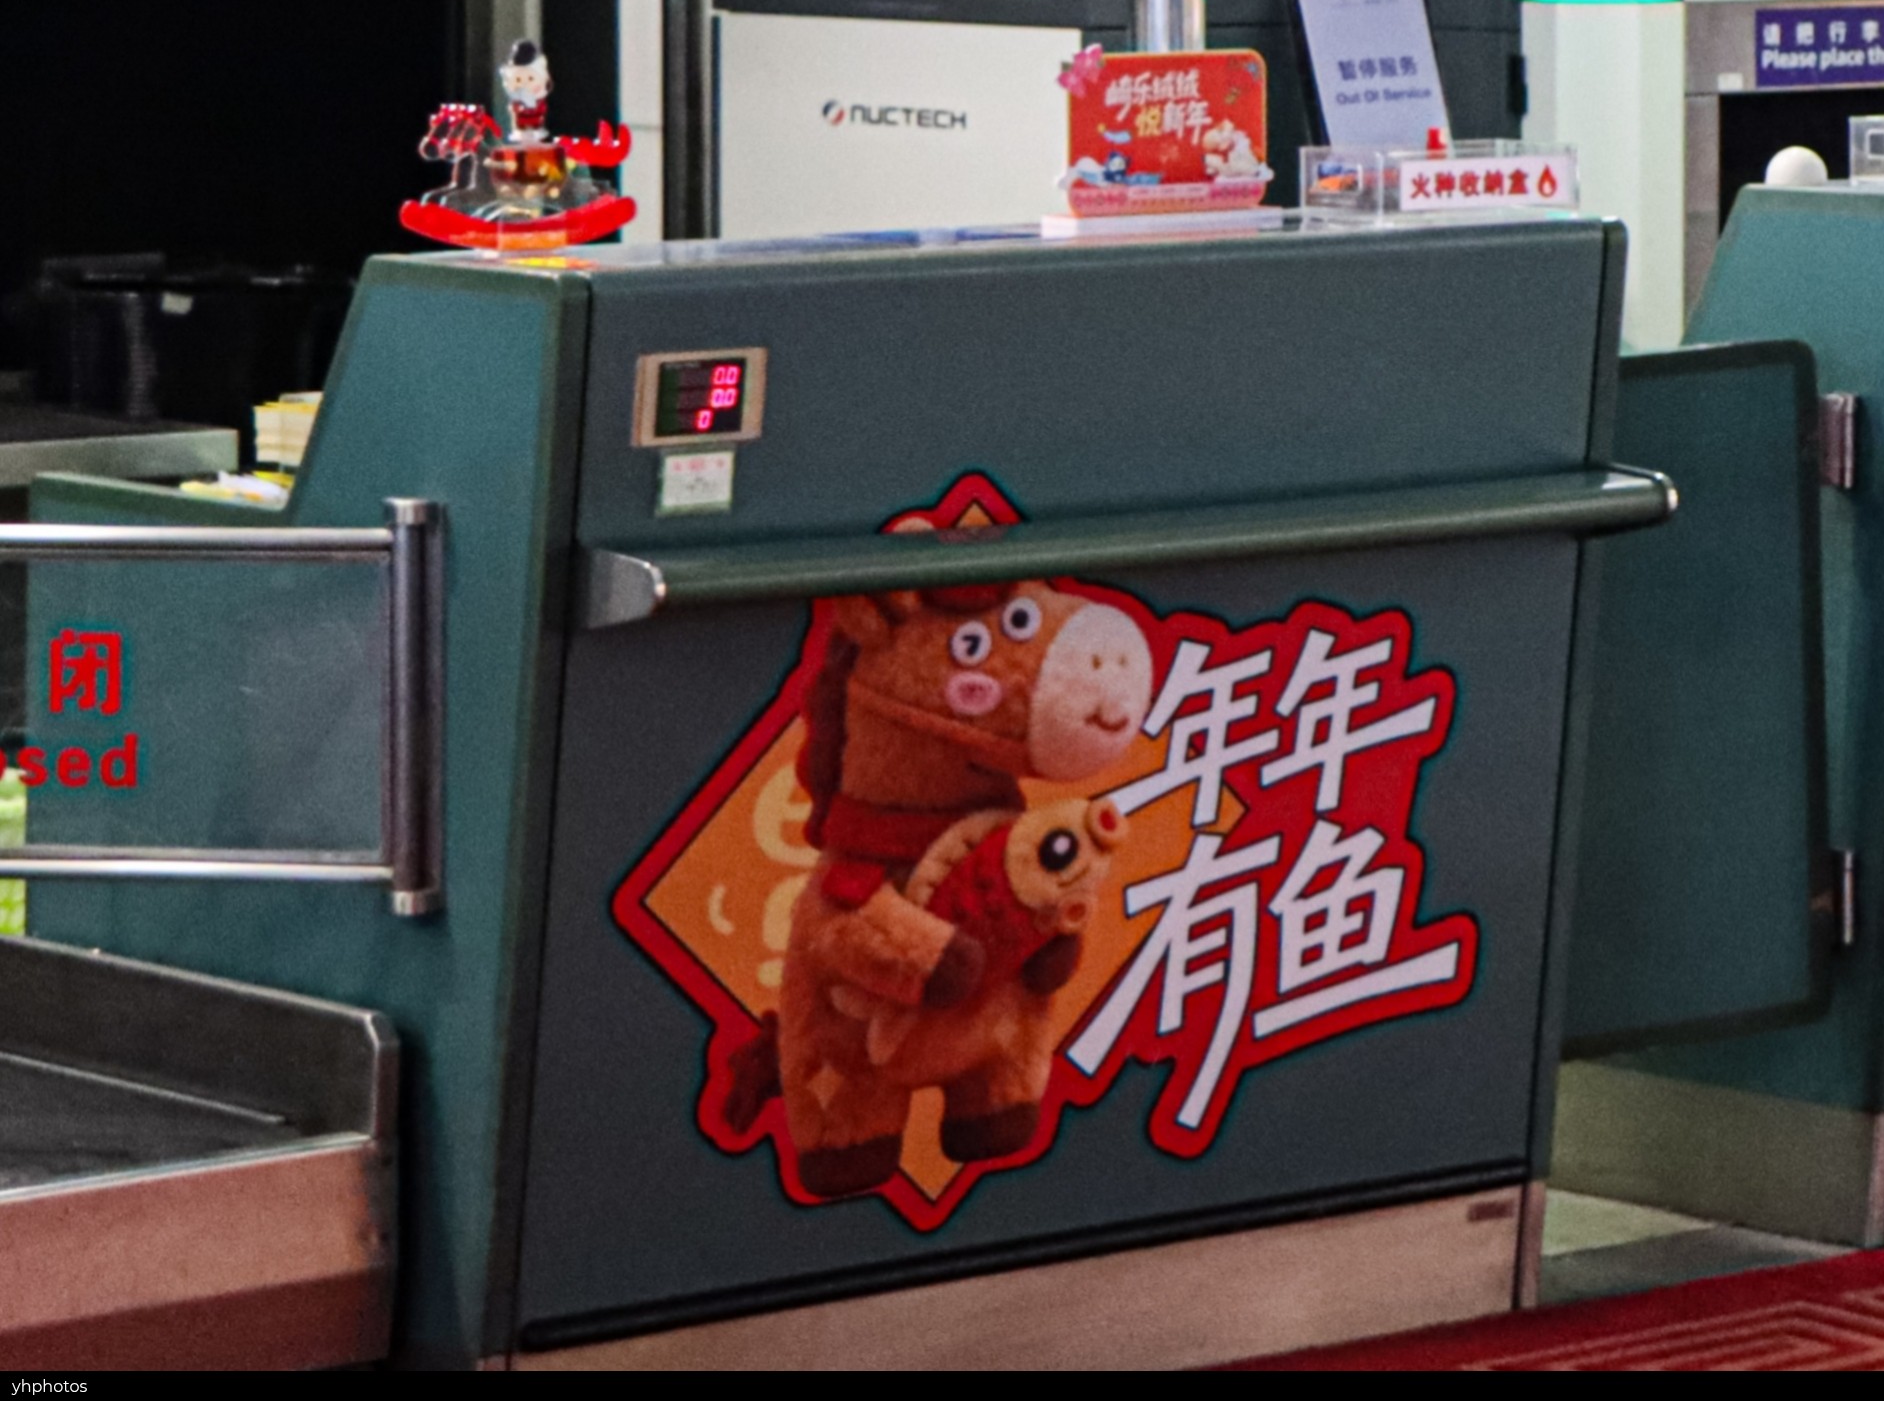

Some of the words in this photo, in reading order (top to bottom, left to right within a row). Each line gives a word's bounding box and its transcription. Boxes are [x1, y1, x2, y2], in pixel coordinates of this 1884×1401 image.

[1762, 49, 1816, 69] Please
[1820, 47, 1865, 71] place
[49, 628, 122, 716] 闭
[0, 734, 138, 789] sed
[1088, 628, 1437, 829] 年年
[1065, 818, 1460, 1130] 有鱼
